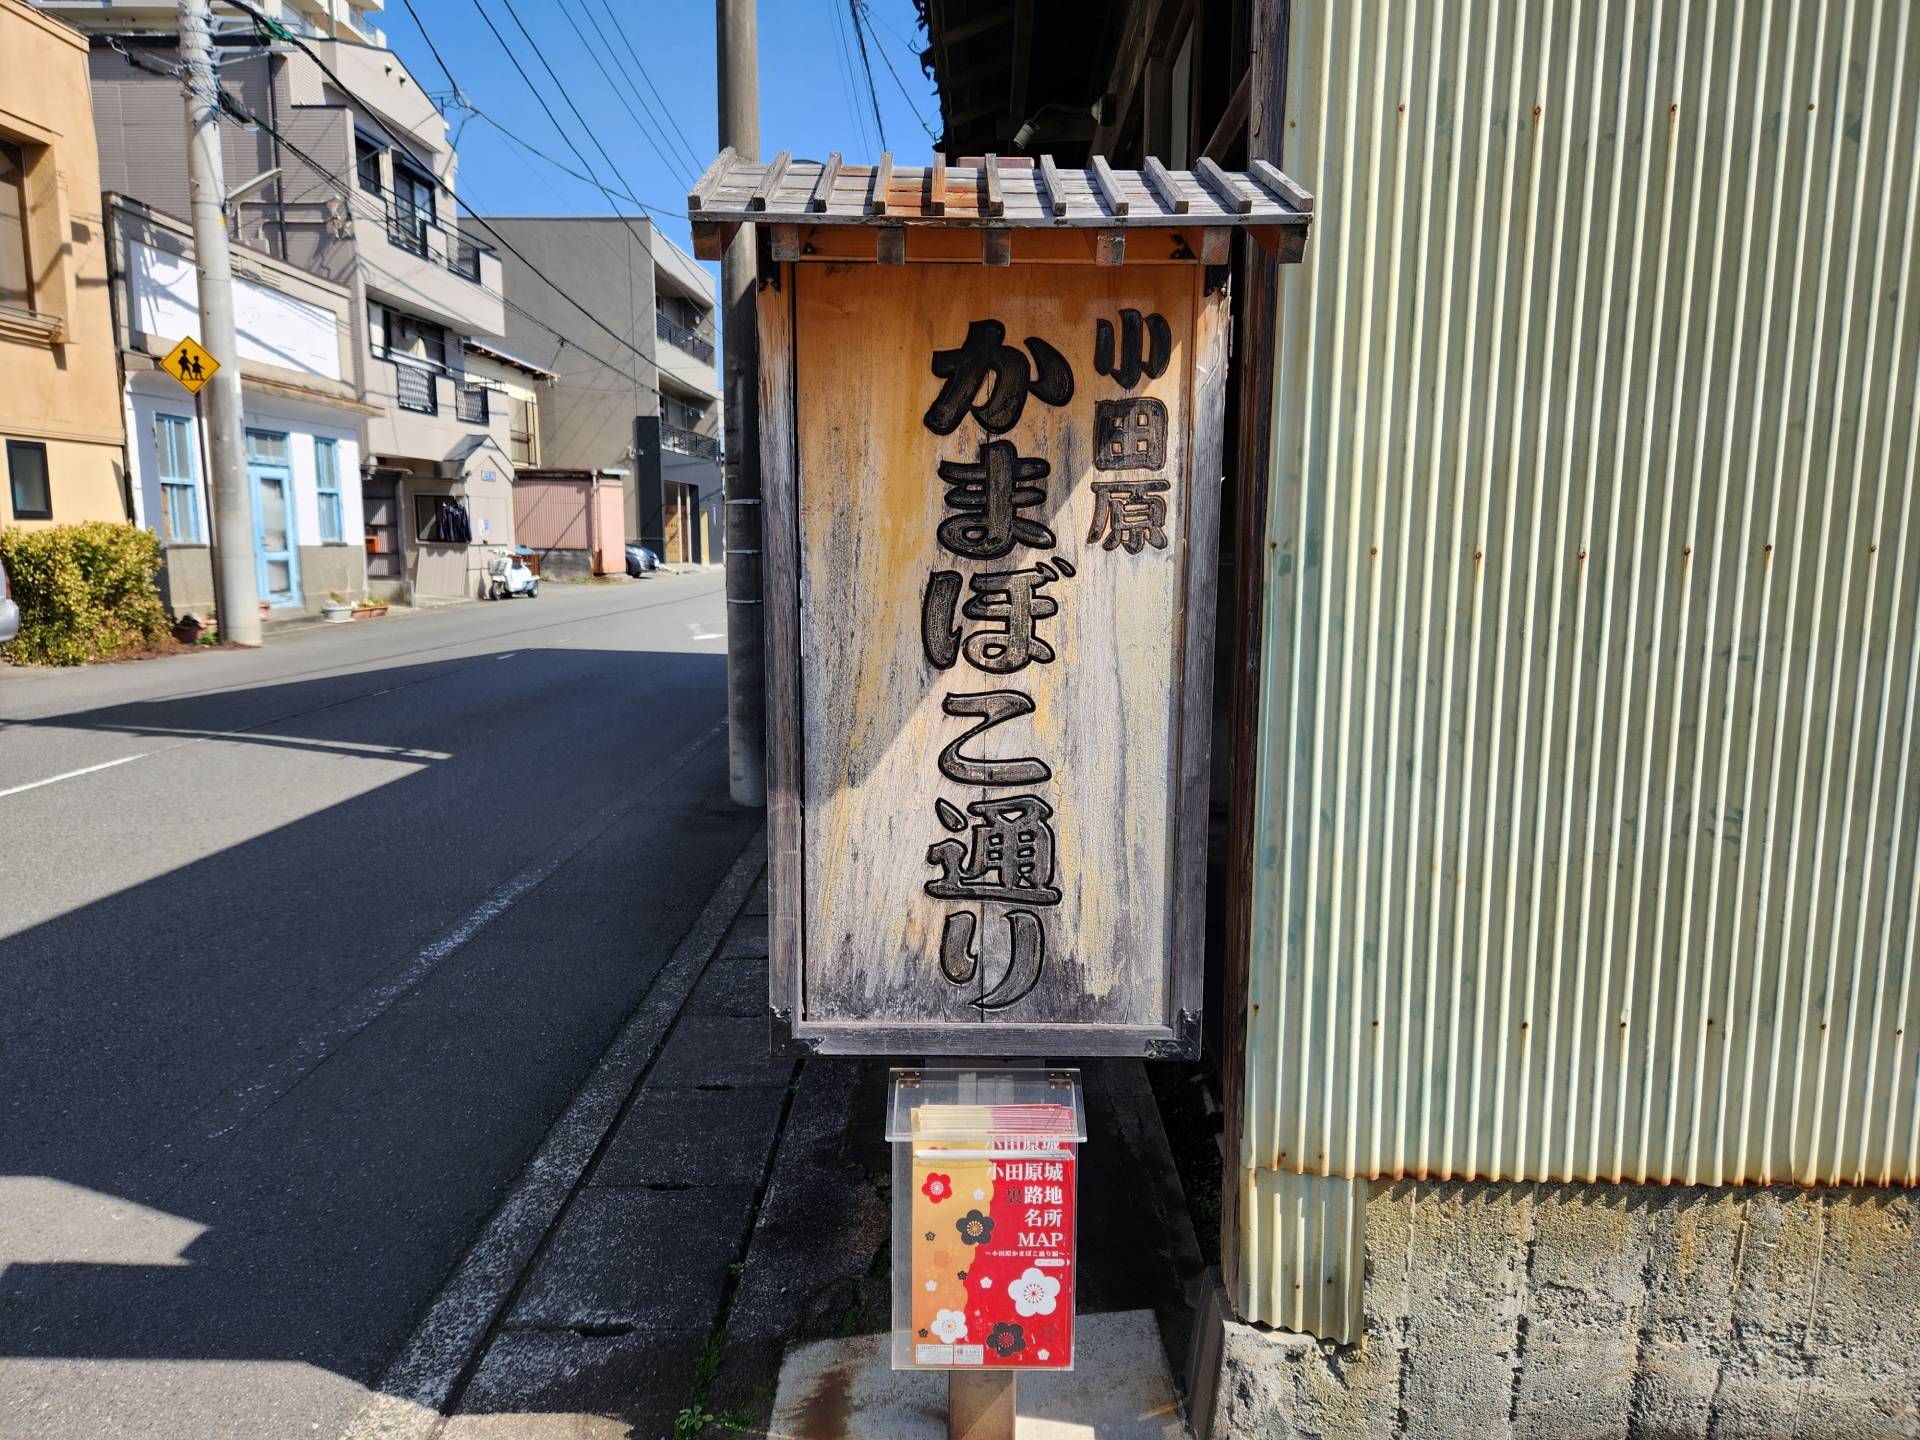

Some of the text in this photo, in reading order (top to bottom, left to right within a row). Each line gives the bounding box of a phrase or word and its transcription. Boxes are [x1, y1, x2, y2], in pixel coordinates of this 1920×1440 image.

[1086, 309, 1172, 554] 小田原
[921, 319, 1076, 1011] かまぼこ通り
[986, 1163, 1063, 1181] 小田原城
[1024, 1209, 1063, 1227] 名所
[1018, 1233, 1063, 1247] MAP
